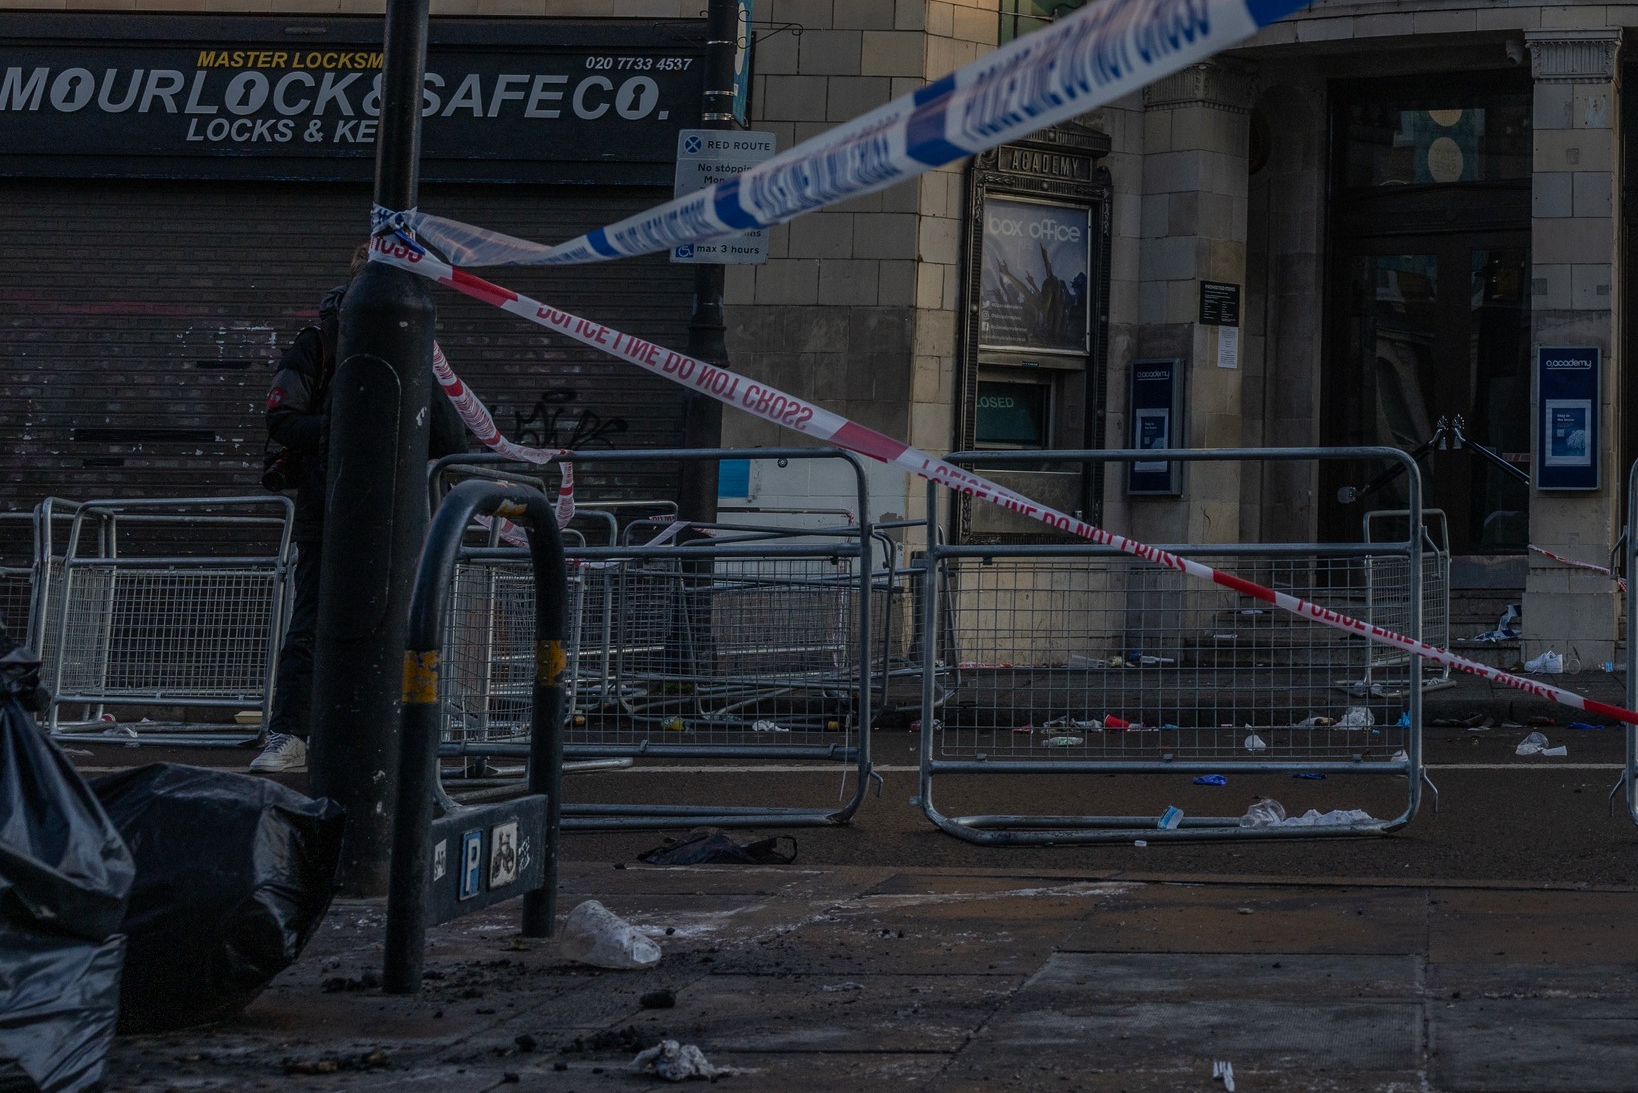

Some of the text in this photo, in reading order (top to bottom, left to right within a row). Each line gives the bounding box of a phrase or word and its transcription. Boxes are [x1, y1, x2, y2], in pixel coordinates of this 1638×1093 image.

[197, 50, 288, 69] MASTER
[586, 56, 693, 72] 020 7733 4537
[187, 117, 379, 143] LOCKS & KE
[707, 140, 771, 151] RED ROUTE
[698, 163, 712, 172] No
[1012, 149, 1079, 177] ACADEMY
[990, 212, 1081, 243] box office
[696, 244, 760, 254] max 3 hours
[464, 837, 481, 895] P
